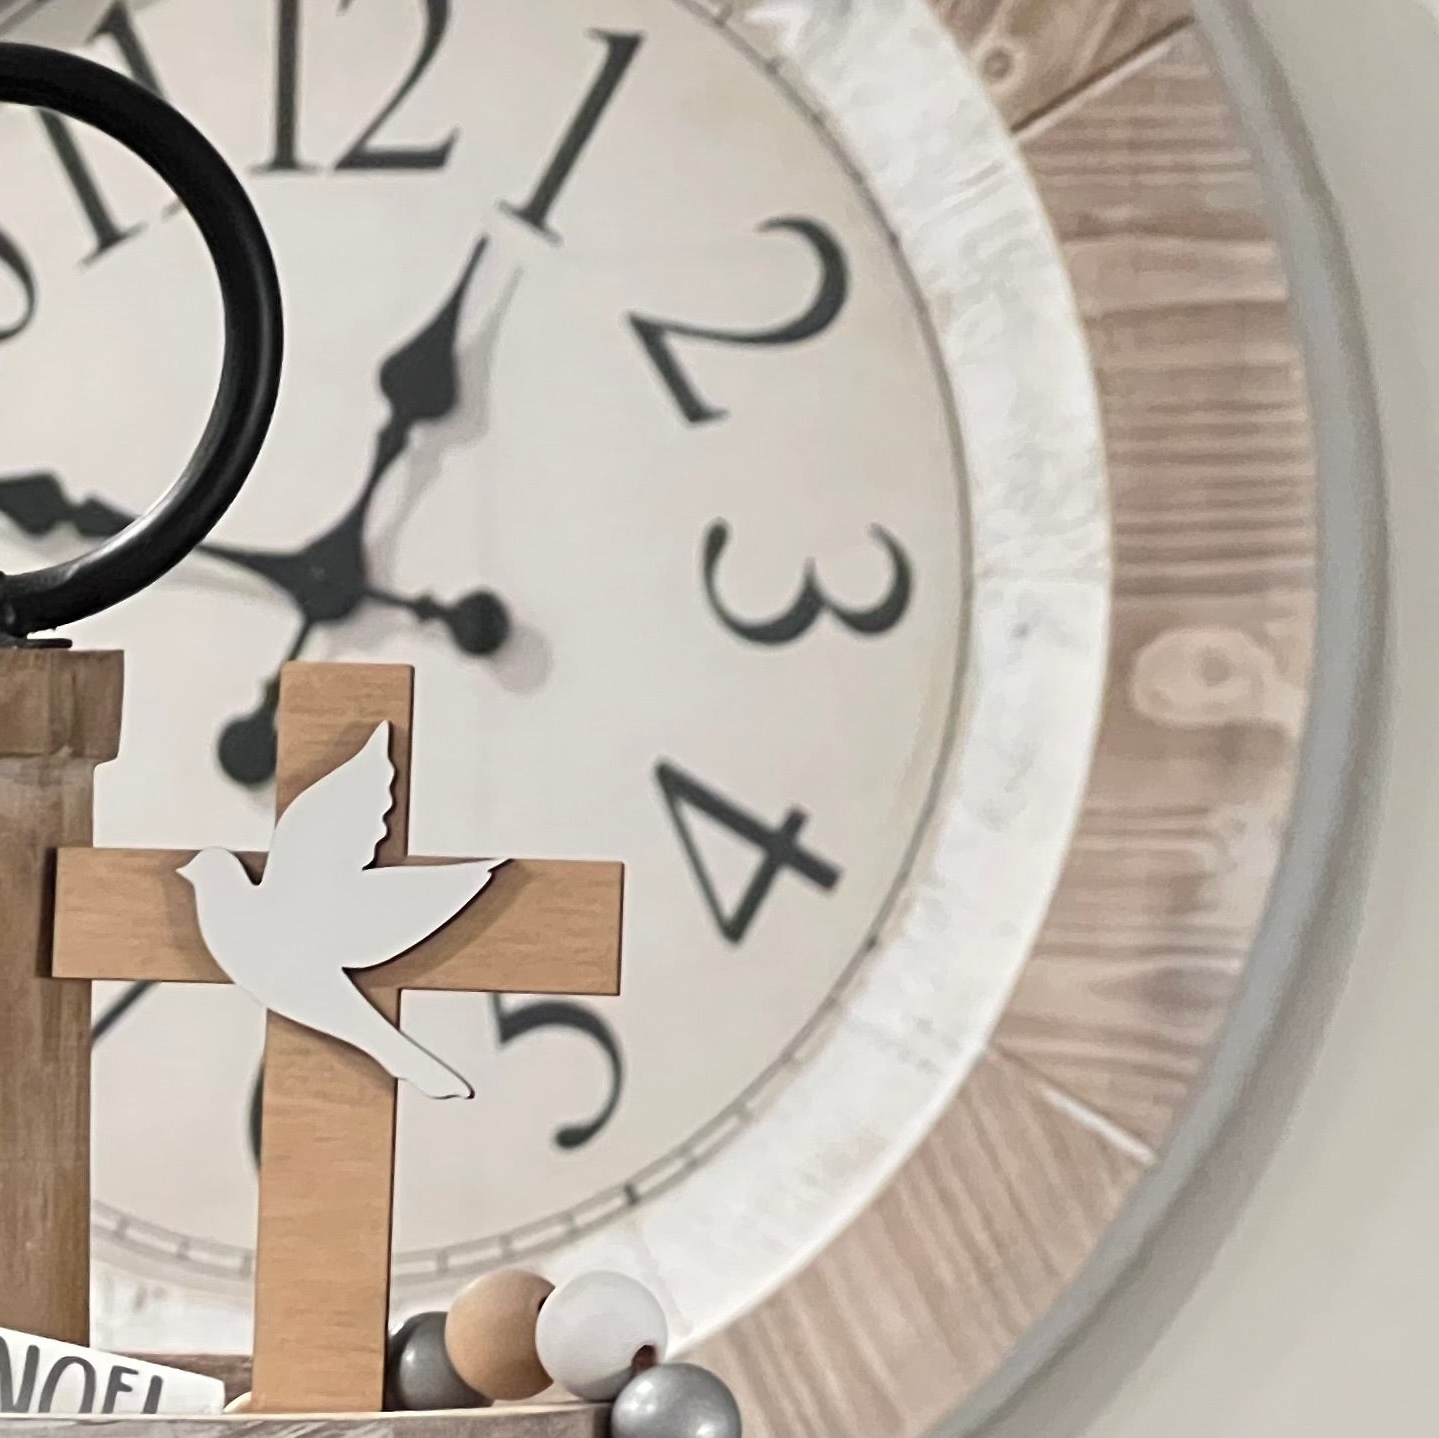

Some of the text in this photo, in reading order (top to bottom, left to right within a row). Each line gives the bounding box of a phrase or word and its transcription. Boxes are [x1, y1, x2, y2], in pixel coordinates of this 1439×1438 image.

[248, 0, 458, 174] 12
[498, 29, 646, 247] 1
[628, 216, 850, 425] 2
[702, 522, 914, 648] 3
[654, 757, 843, 947] 4
